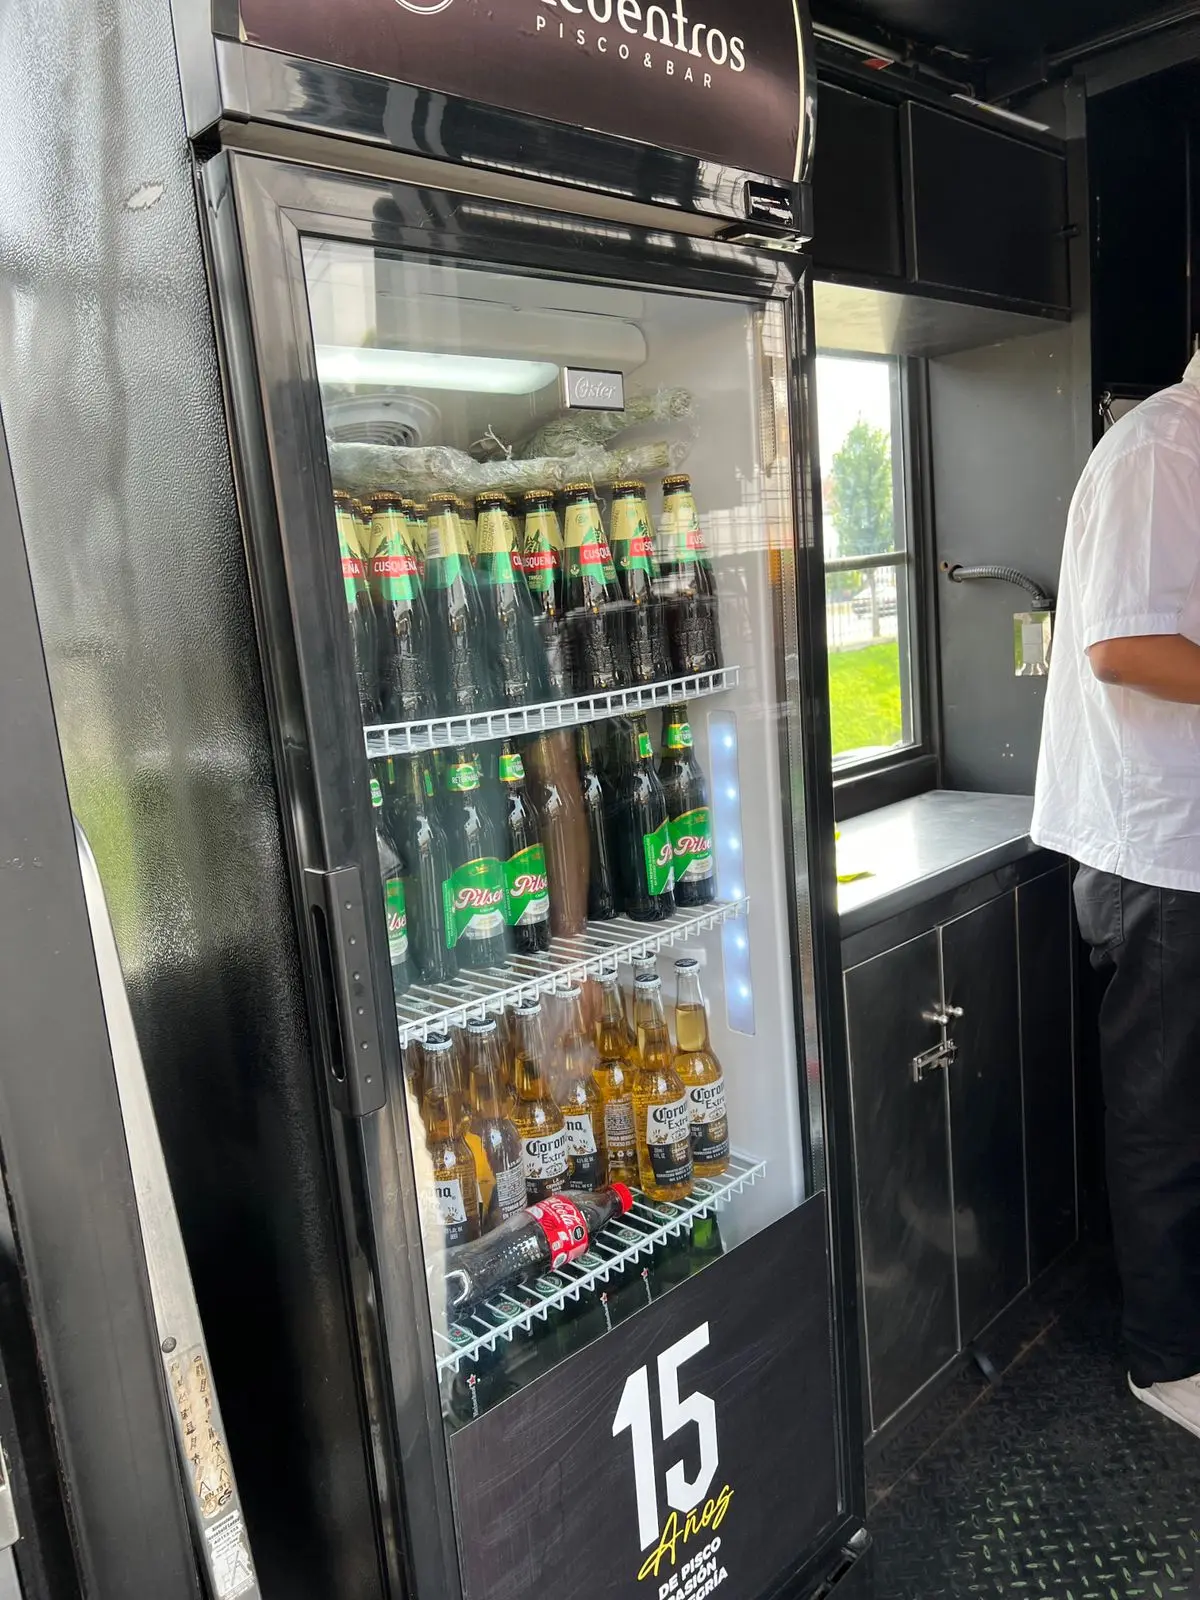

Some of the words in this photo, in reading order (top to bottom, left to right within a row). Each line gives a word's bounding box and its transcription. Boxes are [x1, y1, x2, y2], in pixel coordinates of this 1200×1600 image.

[374, 557, 418, 572] CUSQUEÑA
[673, 835, 712, 857] Pils
[510, 874, 547, 897] Pils
[455, 887, 503, 909] Pilse
[690, 1081, 725, 1105] Coron
[652, 1102, 688, 1125] Coron
[525, 1135, 566, 1159] Coron
[612, 1321, 719, 1552] 15
[637, 1484, 734, 1580] Años
[658, 1573, 679, 1600] DE
[681, 1536, 721, 1581] PISCO
[667, 1556, 717, 1600] ASIÓN
